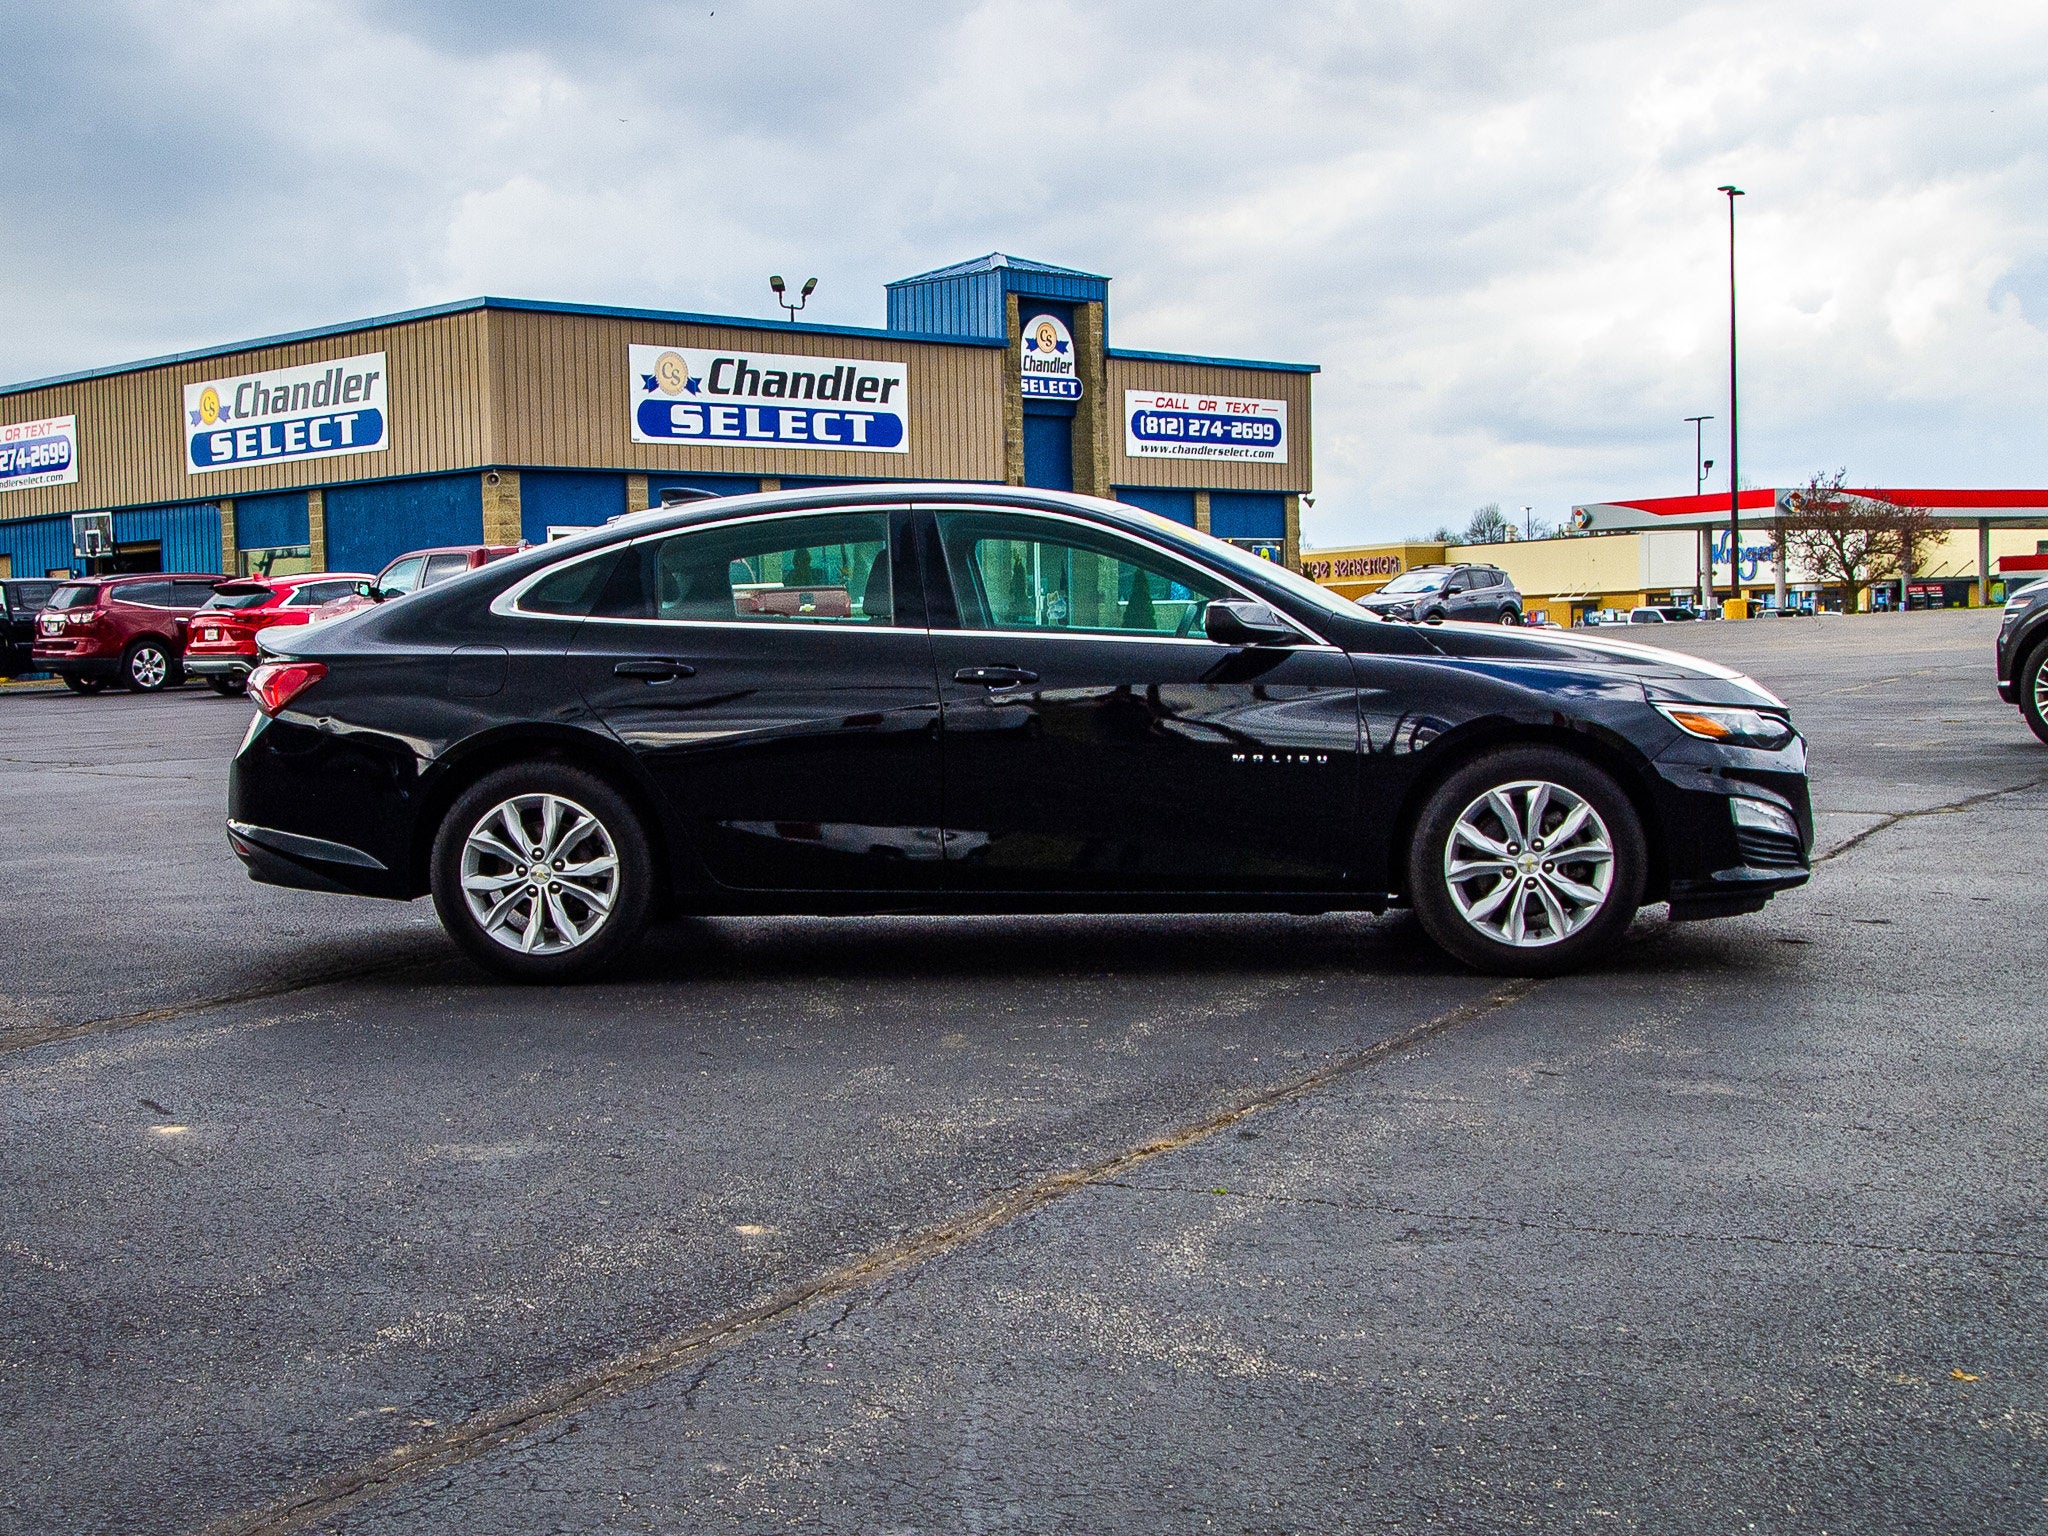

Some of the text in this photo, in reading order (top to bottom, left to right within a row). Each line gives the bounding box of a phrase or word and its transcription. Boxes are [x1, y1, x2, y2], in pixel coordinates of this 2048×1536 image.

[1040, 329, 1053, 347] CS
[661, 361, 681, 387] CS
[1023, 354, 1073, 375] Chandler
[707, 357, 900, 404] Chandler
[1021, 378, 1078, 395] SELECT
[234, 367, 380, 419] Chandler
[203, 396, 215, 417] CS
[1155, 397, 1260, 415] CALL OR TEXT
[5, 423, 53, 441] OR TEXT
[670, 404, 875, 443] SELECT
[1140, 415, 1275, 441] (812) 274-2699
[210, 413, 359, 462] SELECT
[0, 441, 69, 471] 274-2699
[1140, 444, 1275, 459] www.chandlerselect.com
